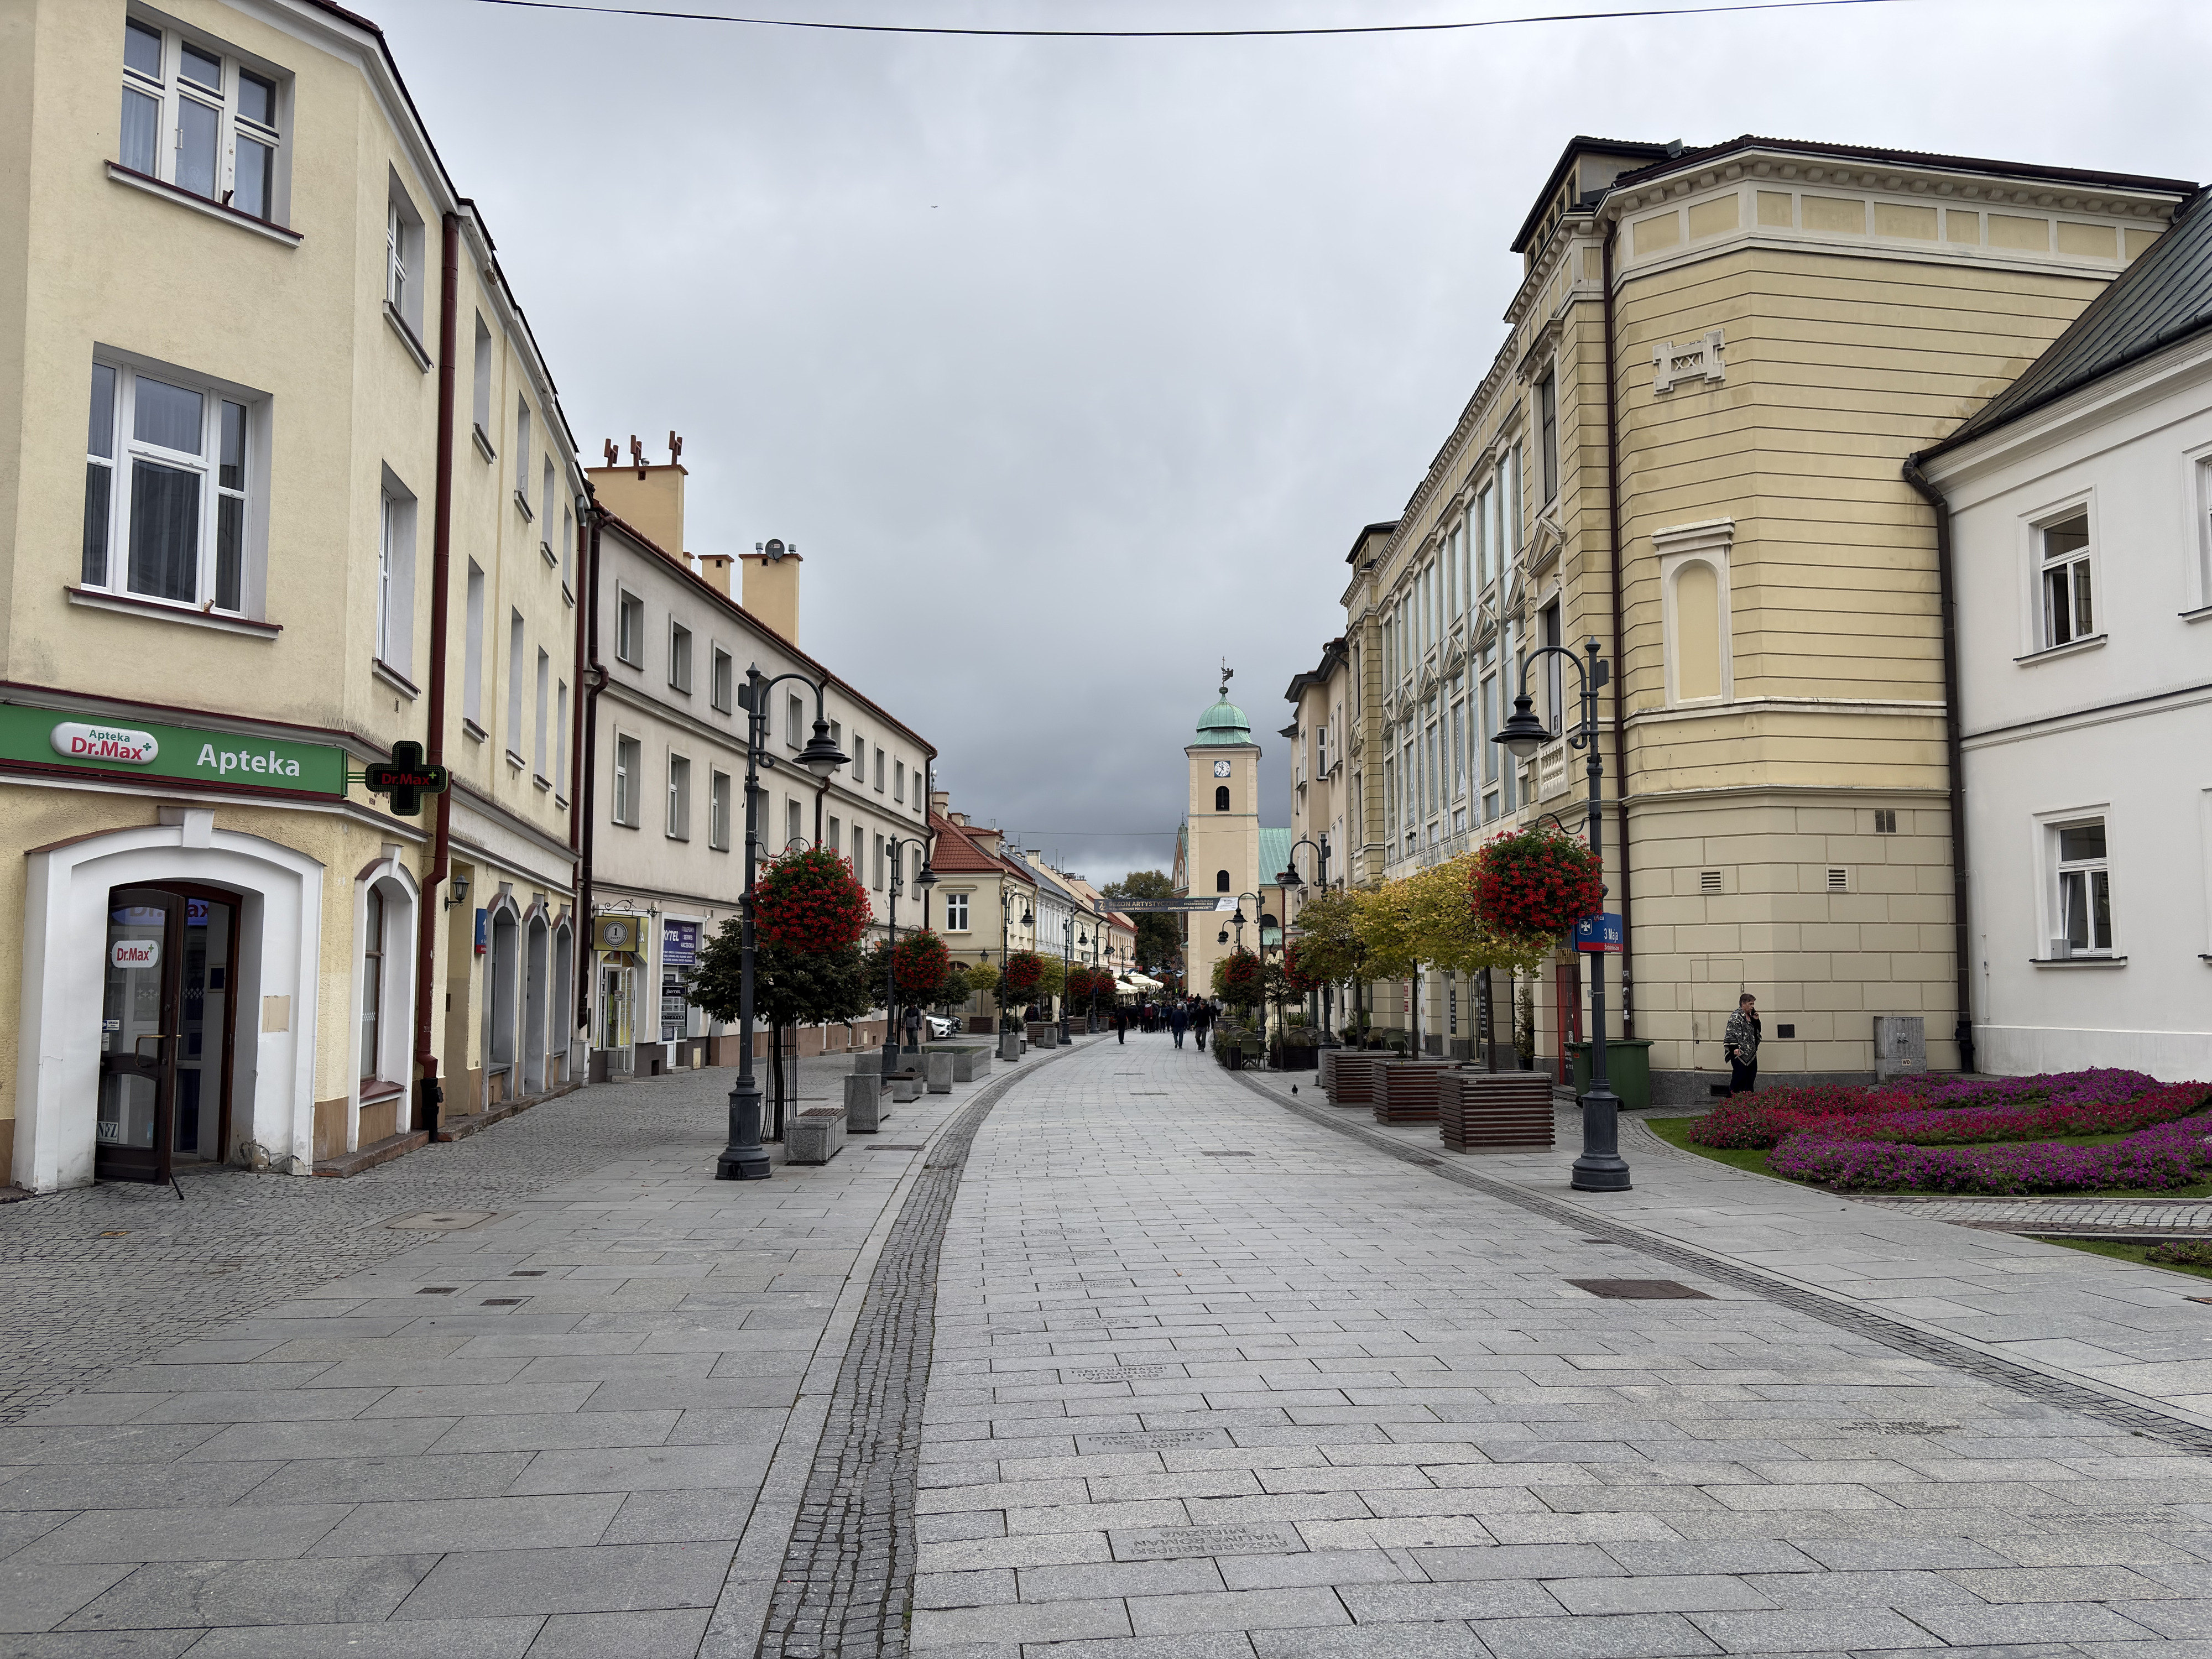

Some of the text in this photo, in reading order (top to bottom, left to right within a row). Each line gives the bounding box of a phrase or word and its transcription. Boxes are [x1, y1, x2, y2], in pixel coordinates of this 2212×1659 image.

[1674, 353, 1703, 371] XXI
[88, 729, 131, 743] Apteka
[71, 737, 143, 760] Dr.Max
[196, 744, 300, 777] Apteka
[382, 773, 430, 785] Dr.Max
[663, 930, 679, 942] KYTEL
[1604, 928, 1619, 943] 3 Maja
[117, 947, 149, 961] Dr.Max
[1158, 1528, 1246, 1537] MIERZWA
[1133, 1534, 1279, 1547] HALINA ROMAN
[1130, 1541, 1288, 1555] RYSZARD KRUPSKI
